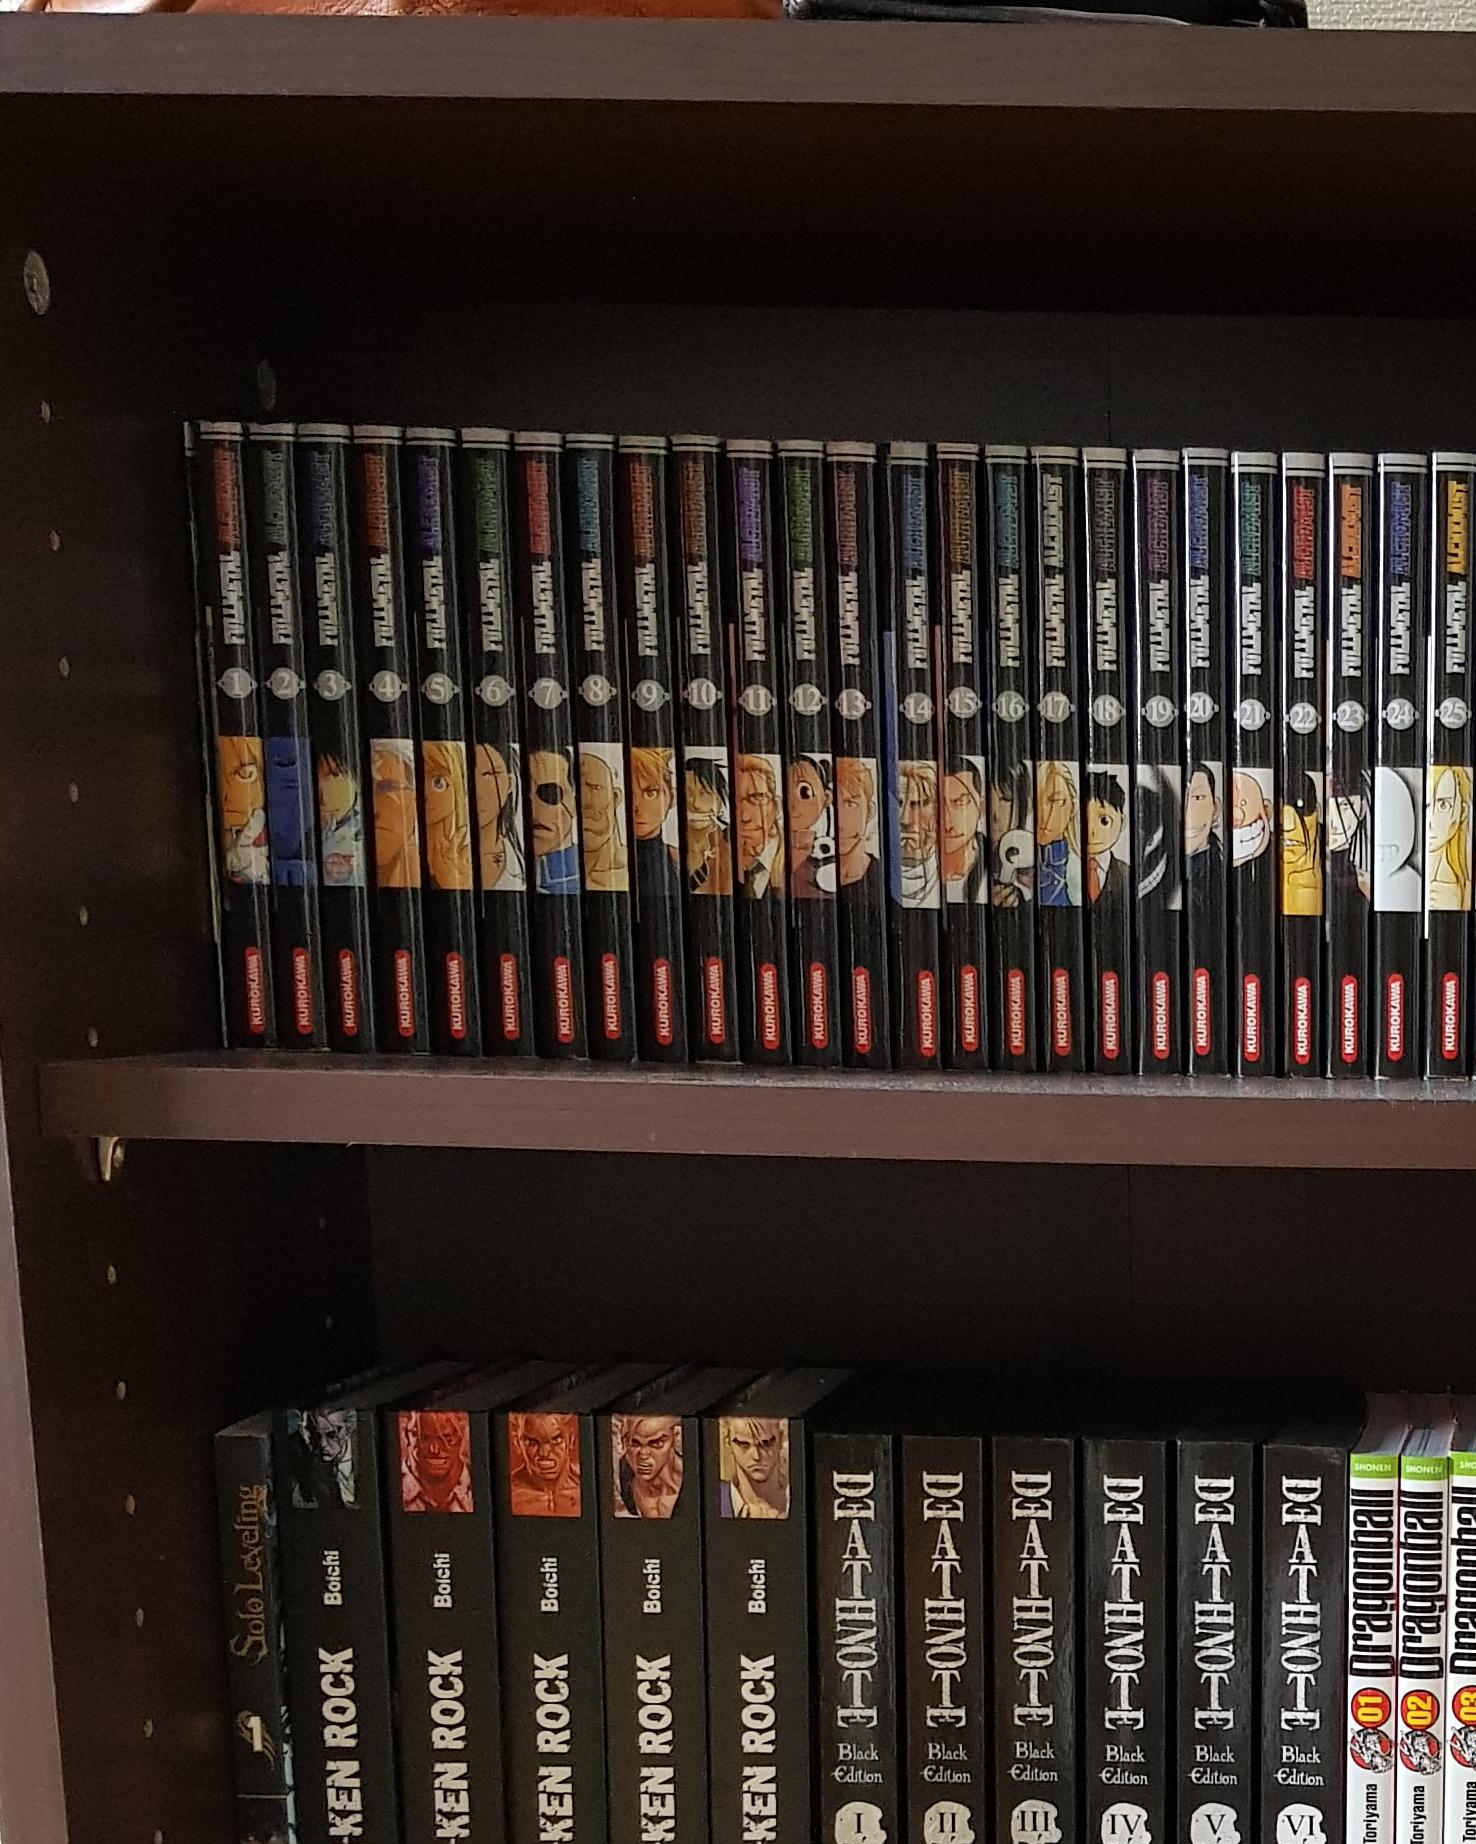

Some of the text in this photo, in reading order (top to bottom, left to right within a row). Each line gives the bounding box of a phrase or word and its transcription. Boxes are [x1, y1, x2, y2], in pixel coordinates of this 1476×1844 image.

[248, 950, 264, 1024] KUROKAWA
[398, 957, 411, 1027] KUROKAWA
[556, 960, 570, 1034] KUROKAWA
[921, 978, 933, 1047] KUROKAWA
[1056, 976, 1067, 1046] KUROKAWA
[1197, 976, 1207, 1046] KUROKAWA
[1445, 980, 1455, 1050] KUROKAWA
[323, 1551, 342, 1605] Boichi
[748, 1560, 765, 1613] Boichi
[1349, 1488, 1394, 1679] Dragonball
[319, 1648, 357, 1747] ROCK
[741, 1655, 775, 1753] ROCK
[1358, 1695, 1382, 1722] 01
[248, 1716, 263, 1752] 1
[838, 1743, 878, 1760] Black
[831, 1765, 883, 1784] Edition
[1019, 1811, 1050, 1831] III
[1110, 1814, 1142, 1835] IV
[1287, 1815, 1315, 1835] VI
[1363, 1784, 1379, 1844] Toriyama
